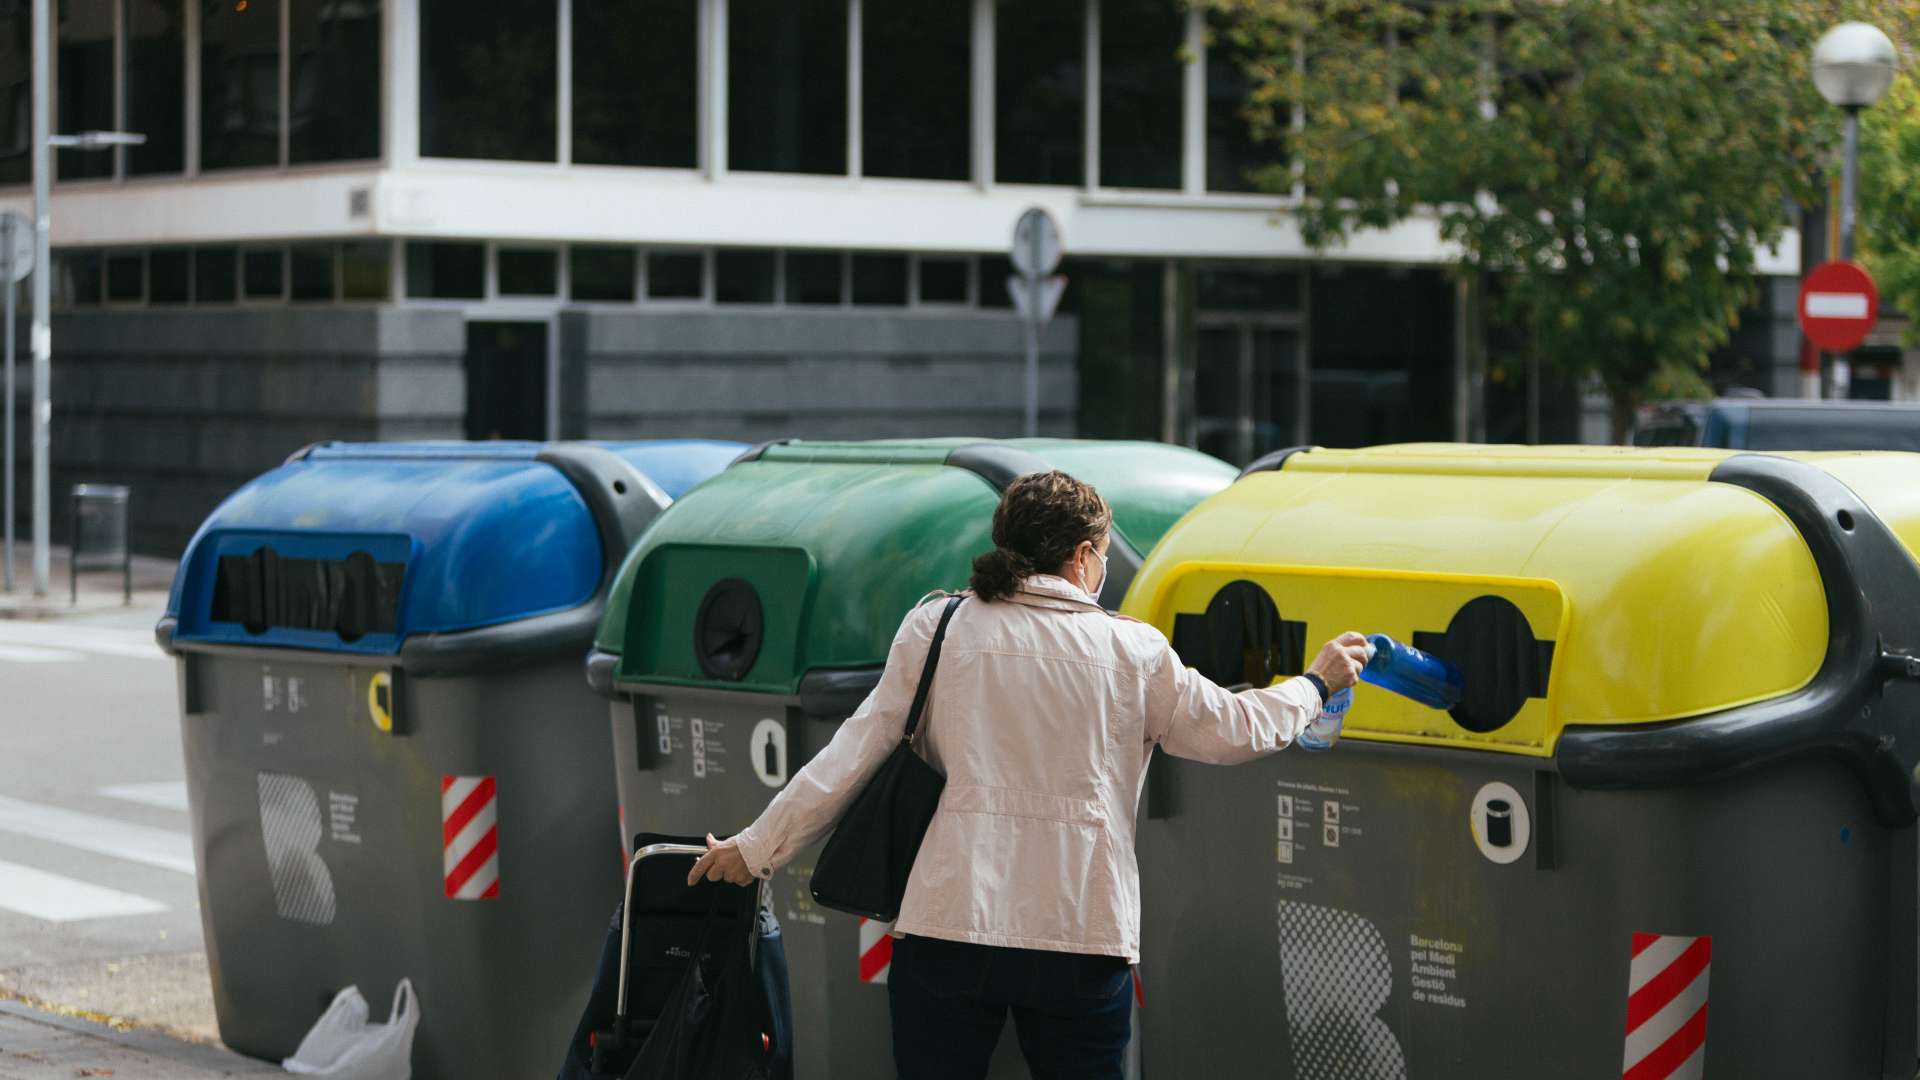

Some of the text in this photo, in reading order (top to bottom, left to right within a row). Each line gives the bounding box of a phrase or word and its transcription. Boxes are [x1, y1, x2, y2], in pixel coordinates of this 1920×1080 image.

[1411, 934, 1463, 953] Barcelona
[1411, 950, 1456, 966] pel Medi
[1412, 962, 1456, 979] Ambient
[1412, 989, 1466, 1008] de residus
